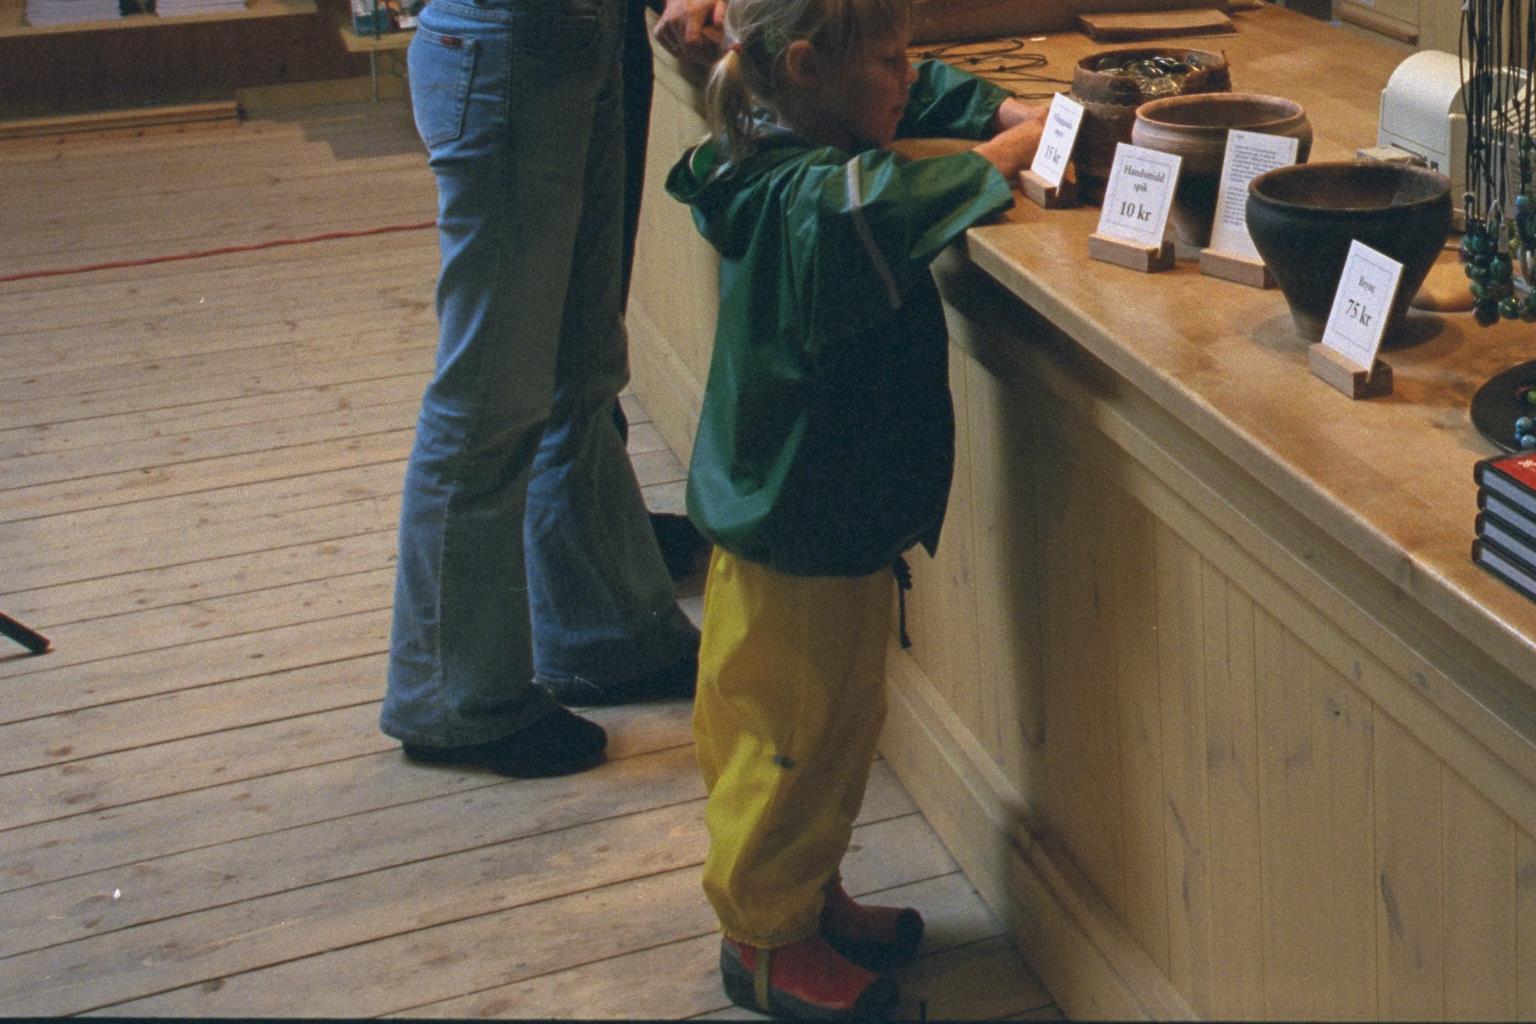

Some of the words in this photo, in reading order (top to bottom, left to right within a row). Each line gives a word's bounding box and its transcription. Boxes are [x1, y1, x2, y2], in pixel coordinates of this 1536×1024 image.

[1044, 145, 1054, 161] 15
[1053, 149, 1061, 164] kr
[1119, 201, 1136, 217] 10
[1137, 204, 1152, 222] kr
[1345, 298, 1360, 319] 75
[1358, 306, 1373, 328] kr
